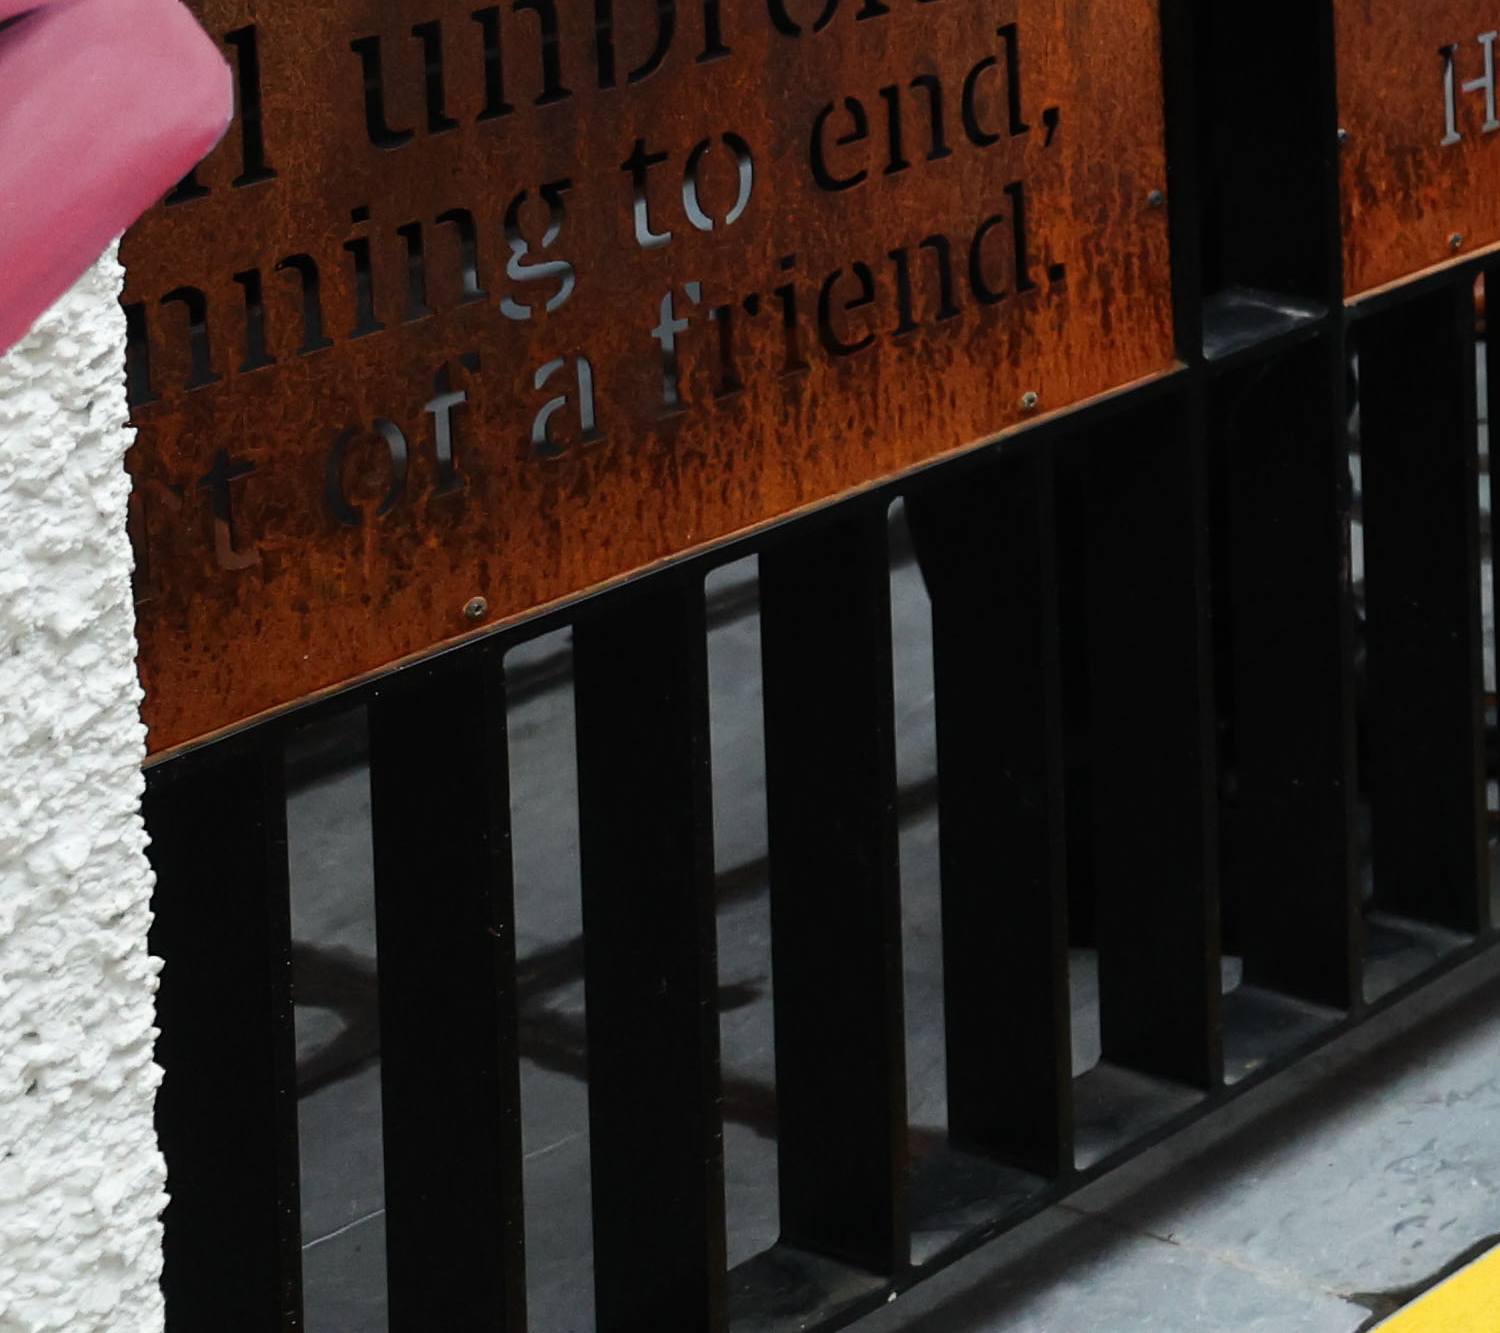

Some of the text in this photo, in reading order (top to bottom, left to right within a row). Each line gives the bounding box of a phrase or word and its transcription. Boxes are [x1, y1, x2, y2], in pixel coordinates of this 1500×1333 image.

[621, 132, 754, 250] to
[809, 23, 1061, 194] end,
[325, 350, 480, 526] of
[532, 353, 596, 460] a
[651, 184, 1065, 421] friend.
